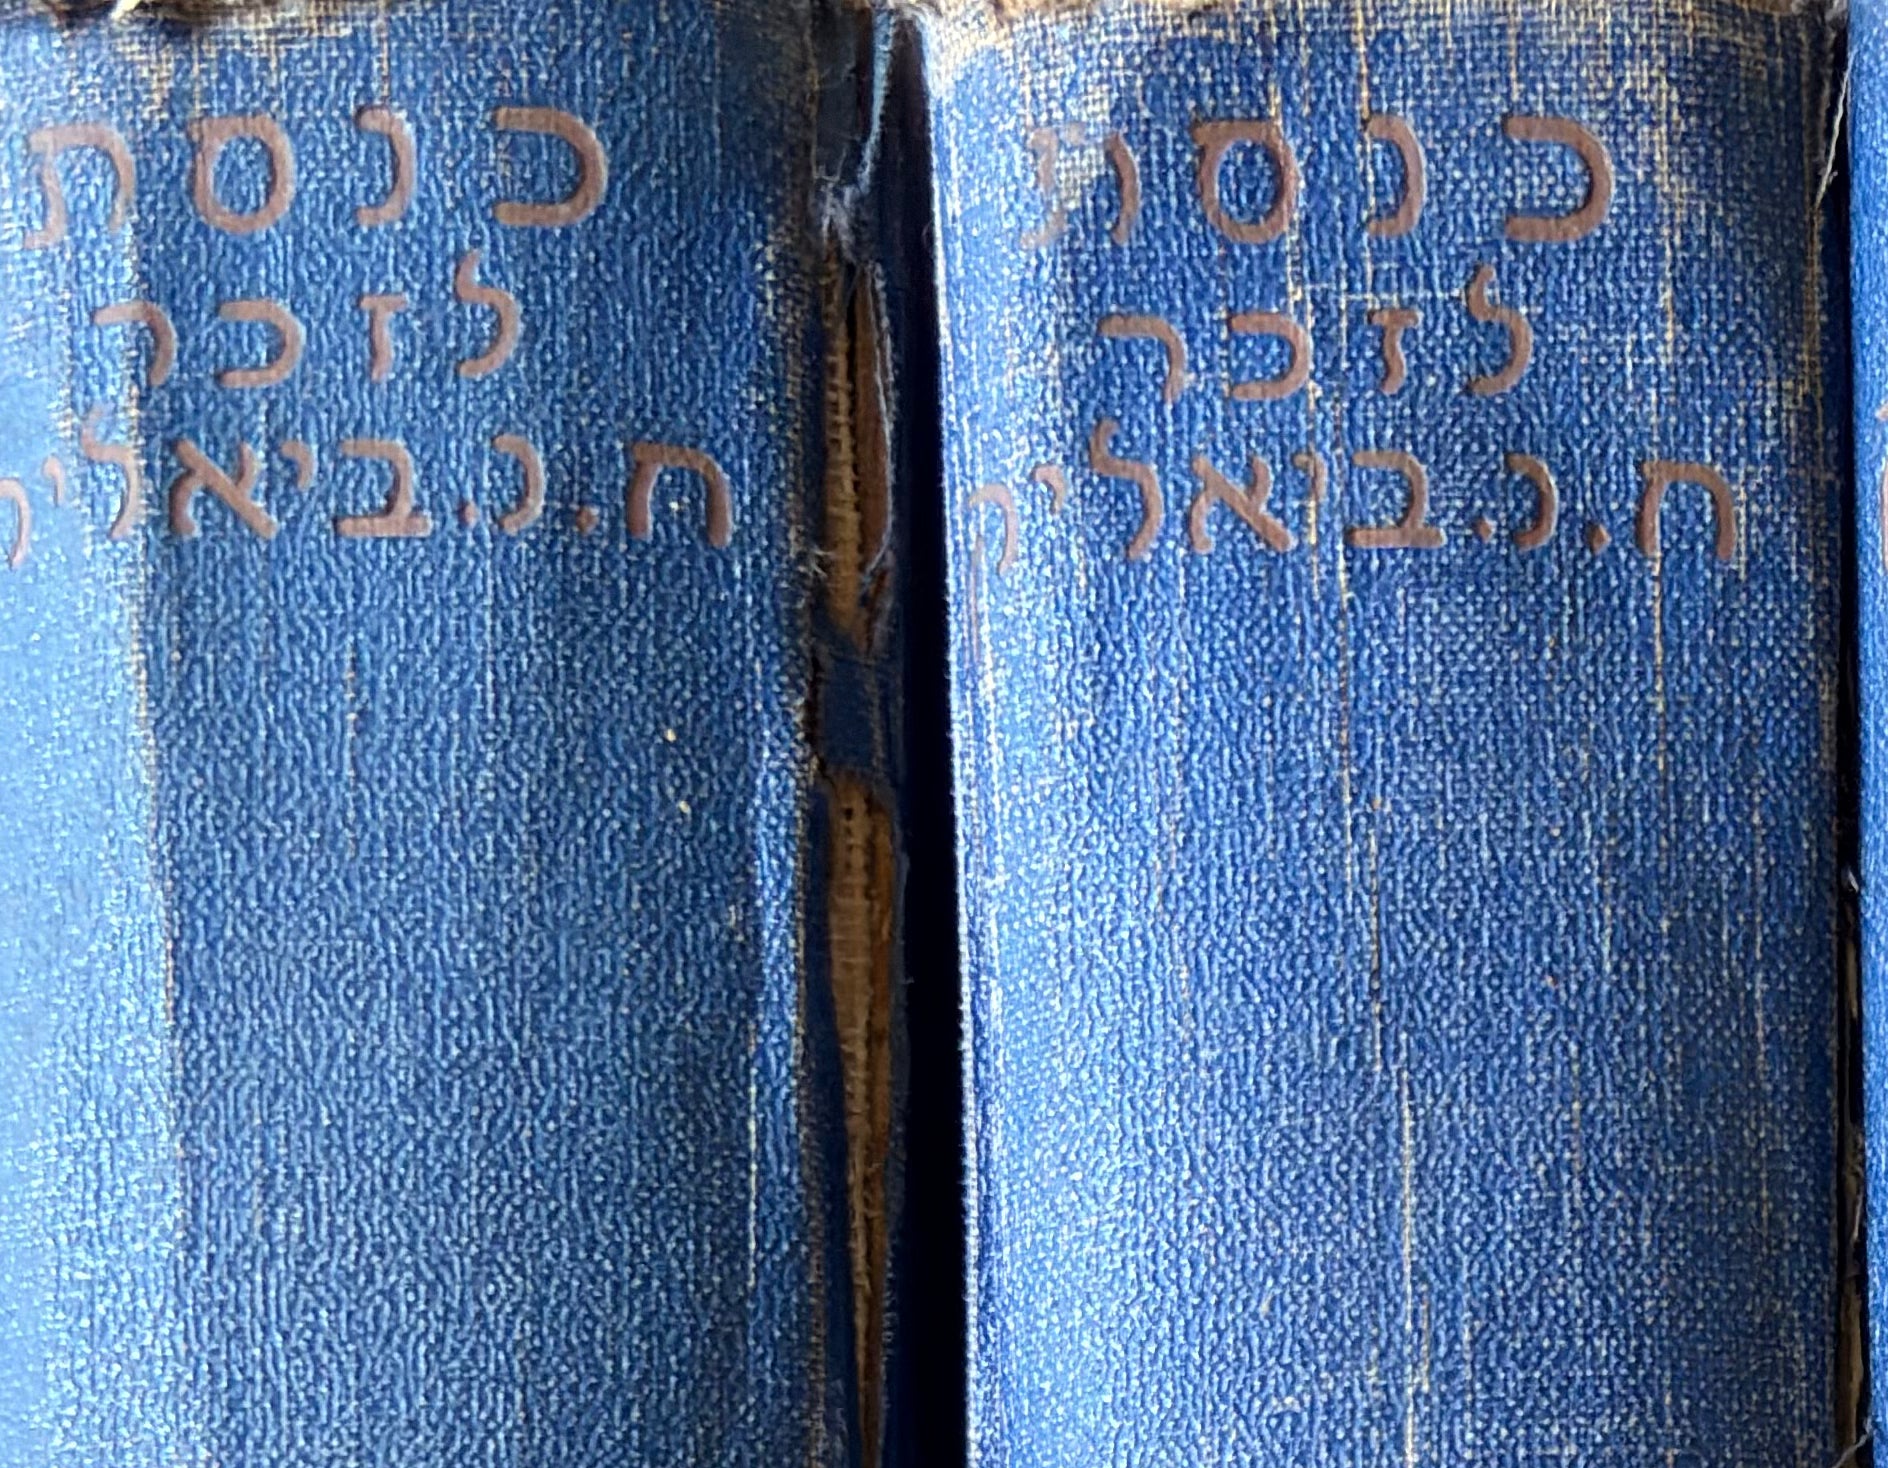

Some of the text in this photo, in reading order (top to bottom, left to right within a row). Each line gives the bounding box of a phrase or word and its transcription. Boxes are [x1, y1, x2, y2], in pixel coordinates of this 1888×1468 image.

[24, 106, 609, 250] כנסת
[1020, 115, 1614, 247] כנסת
[94, 250, 522, 388] לזכר
[1098, 263, 1534, 402] לזכר
